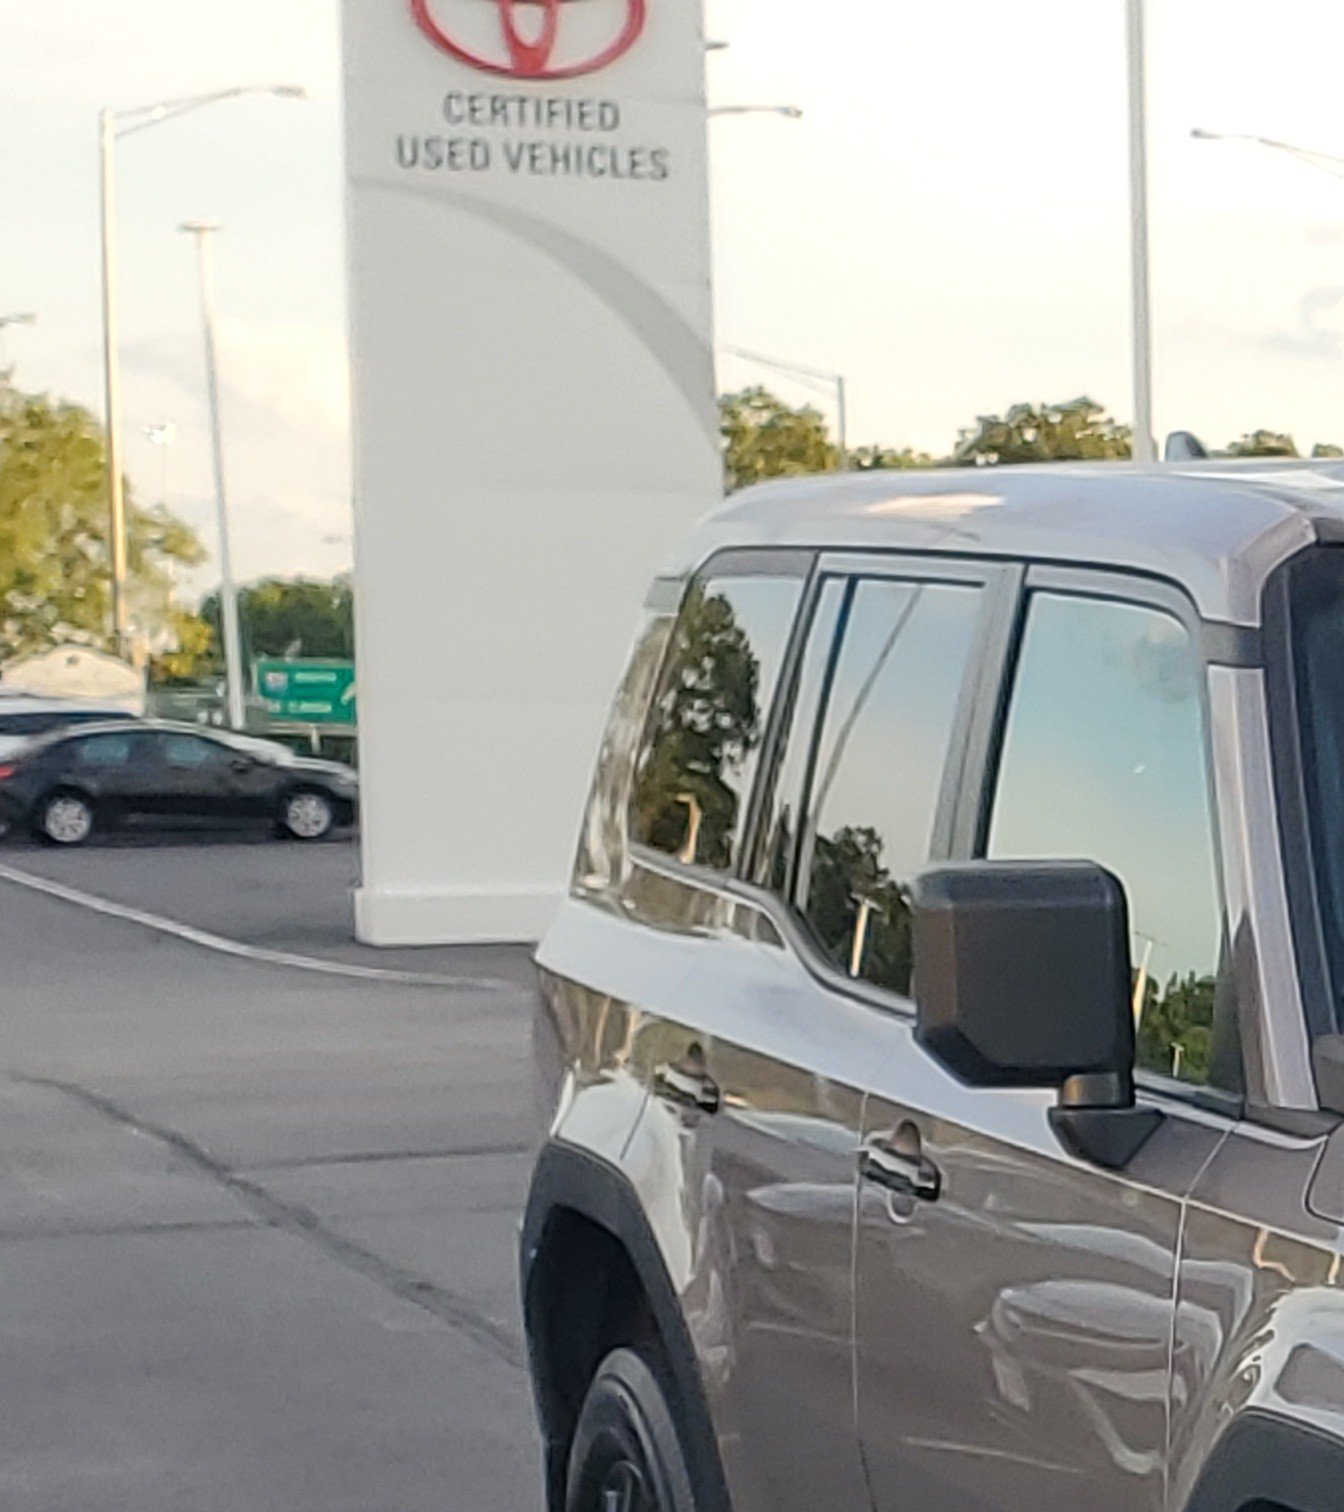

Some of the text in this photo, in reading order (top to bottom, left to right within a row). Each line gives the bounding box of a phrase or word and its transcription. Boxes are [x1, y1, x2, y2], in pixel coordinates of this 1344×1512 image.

[443, 92, 621, 132] CERTIFIED
[396, 134, 671, 181] USED VEHICLES
